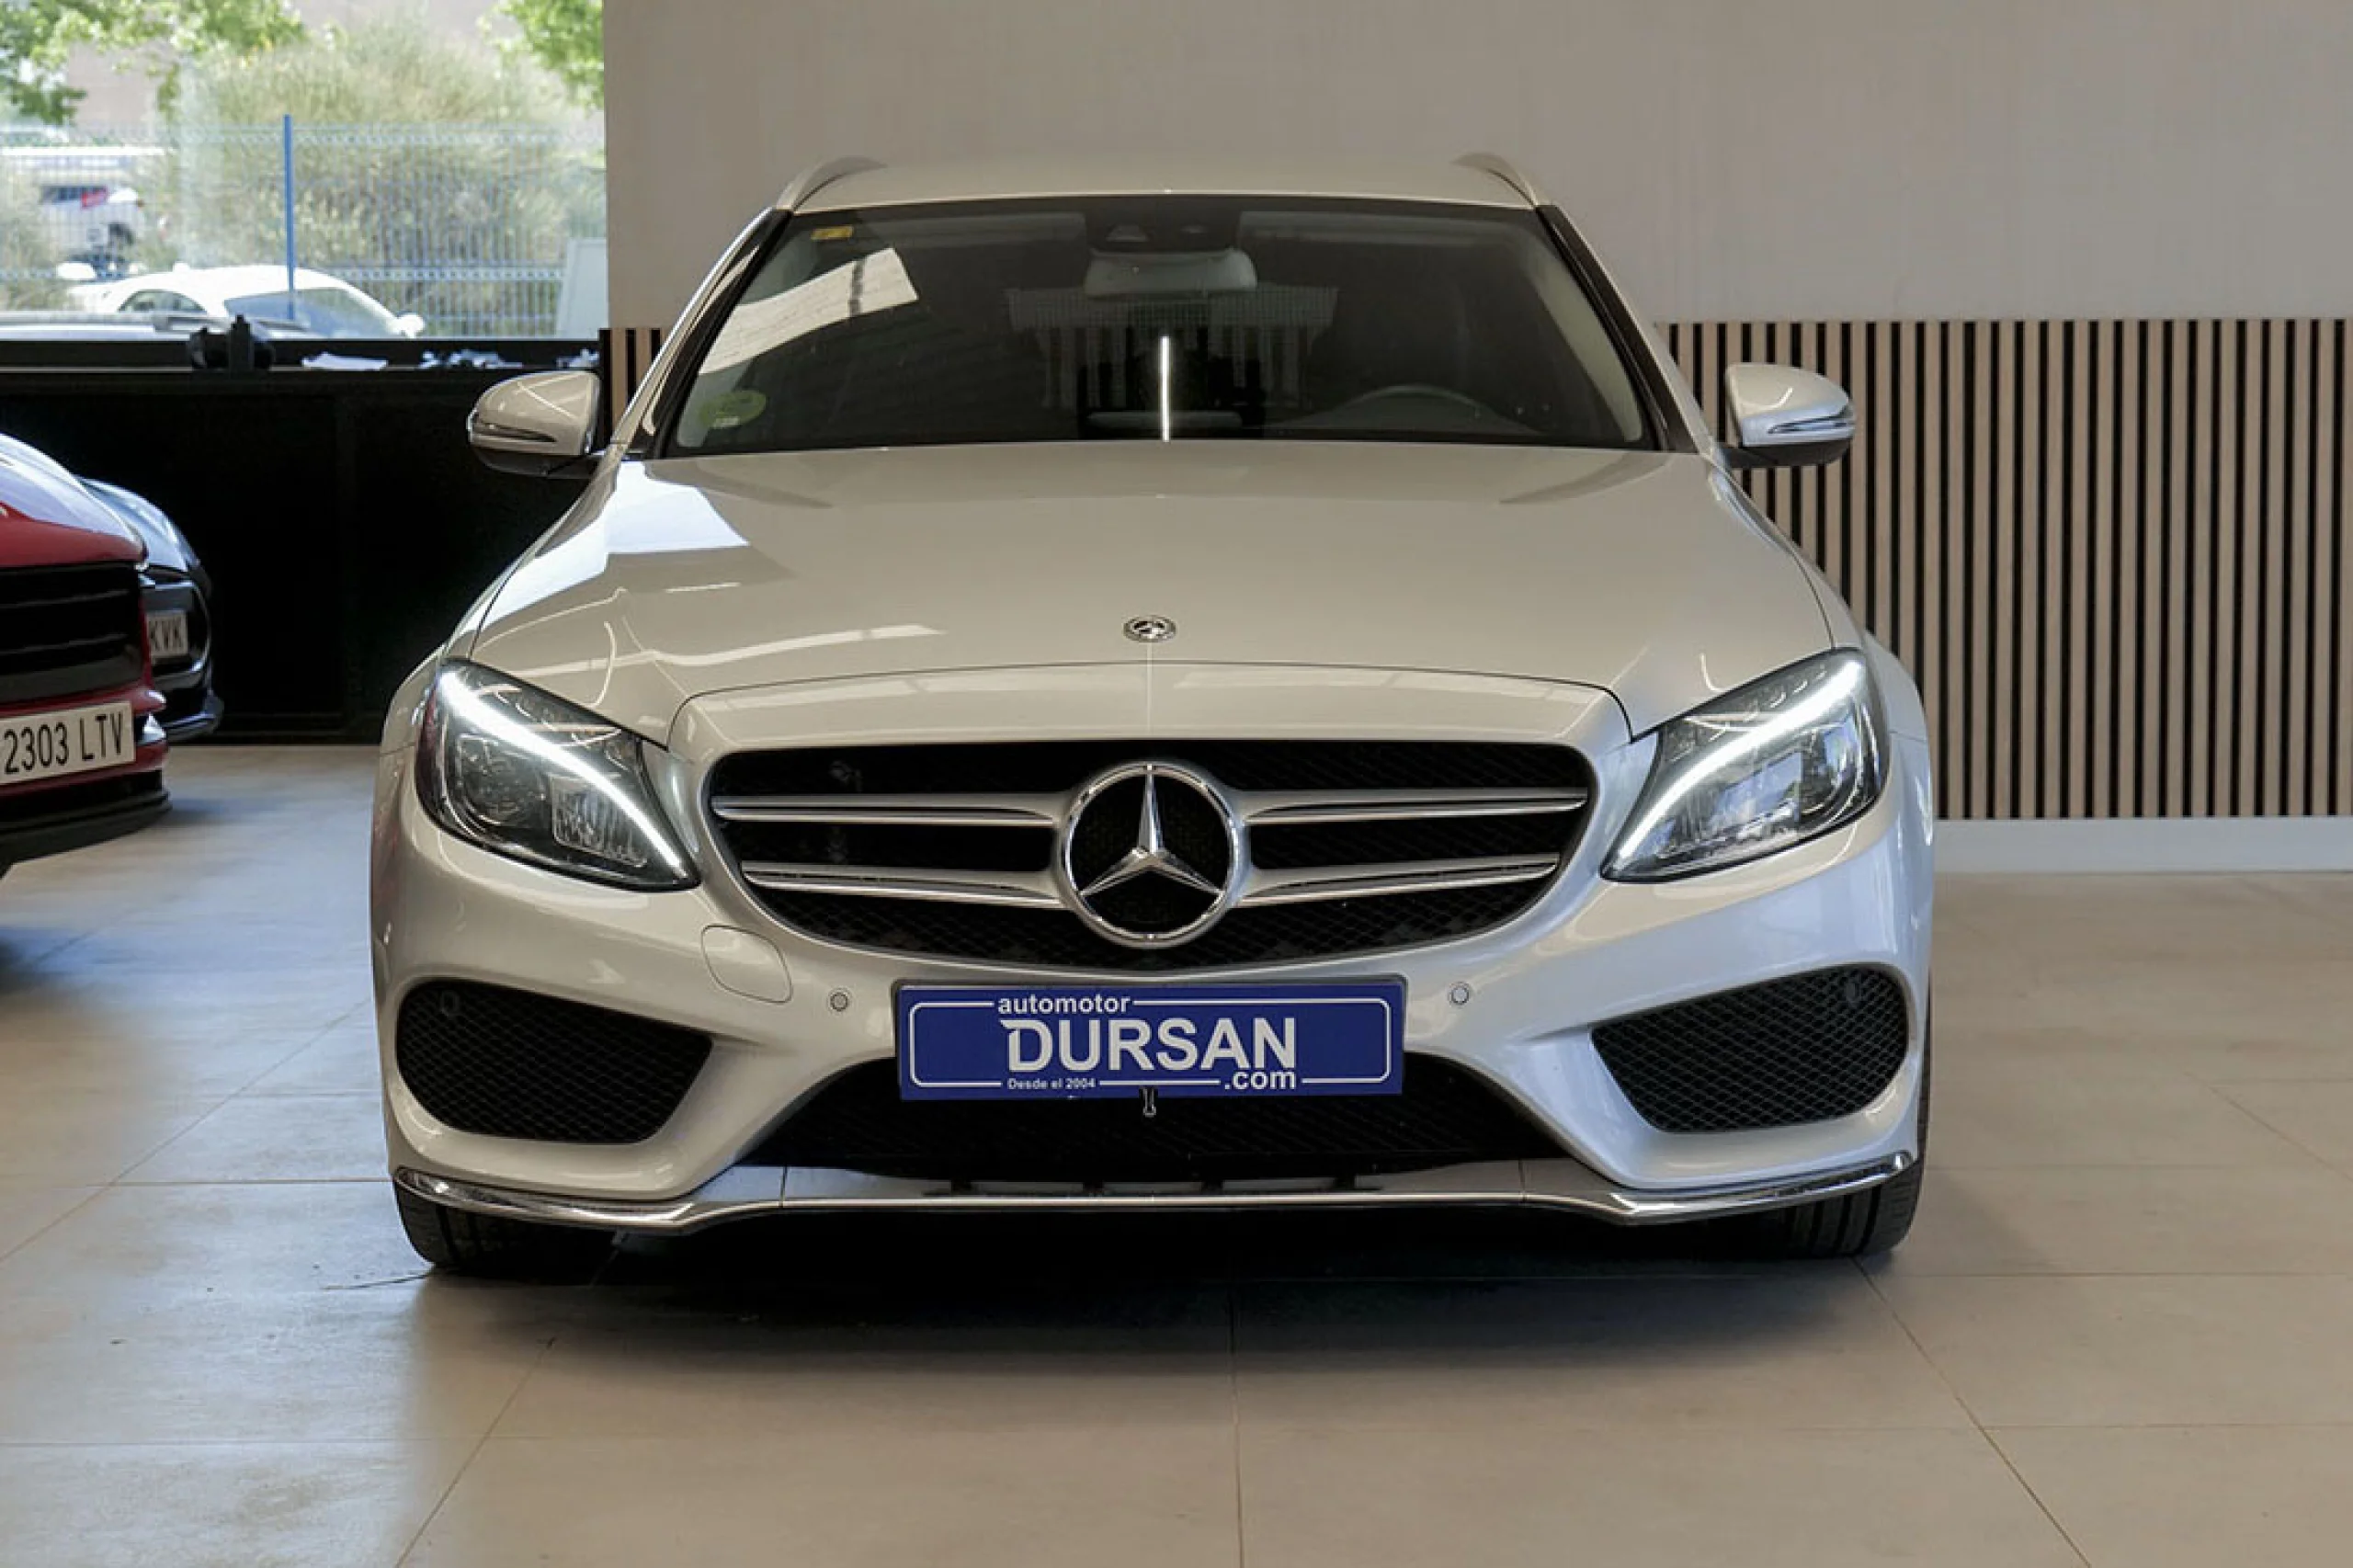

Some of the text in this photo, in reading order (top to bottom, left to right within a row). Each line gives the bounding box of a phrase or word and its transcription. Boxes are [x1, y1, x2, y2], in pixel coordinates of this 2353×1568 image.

[4, 710, 124, 775] 2303 LTV
[998, 994, 1131, 1015] automotor
[999, 1017, 1296, 1072] DURSAN
[1007, 1077, 1097, 1090] Desde el 2004
[1223, 1071, 1297, 1091] .com
